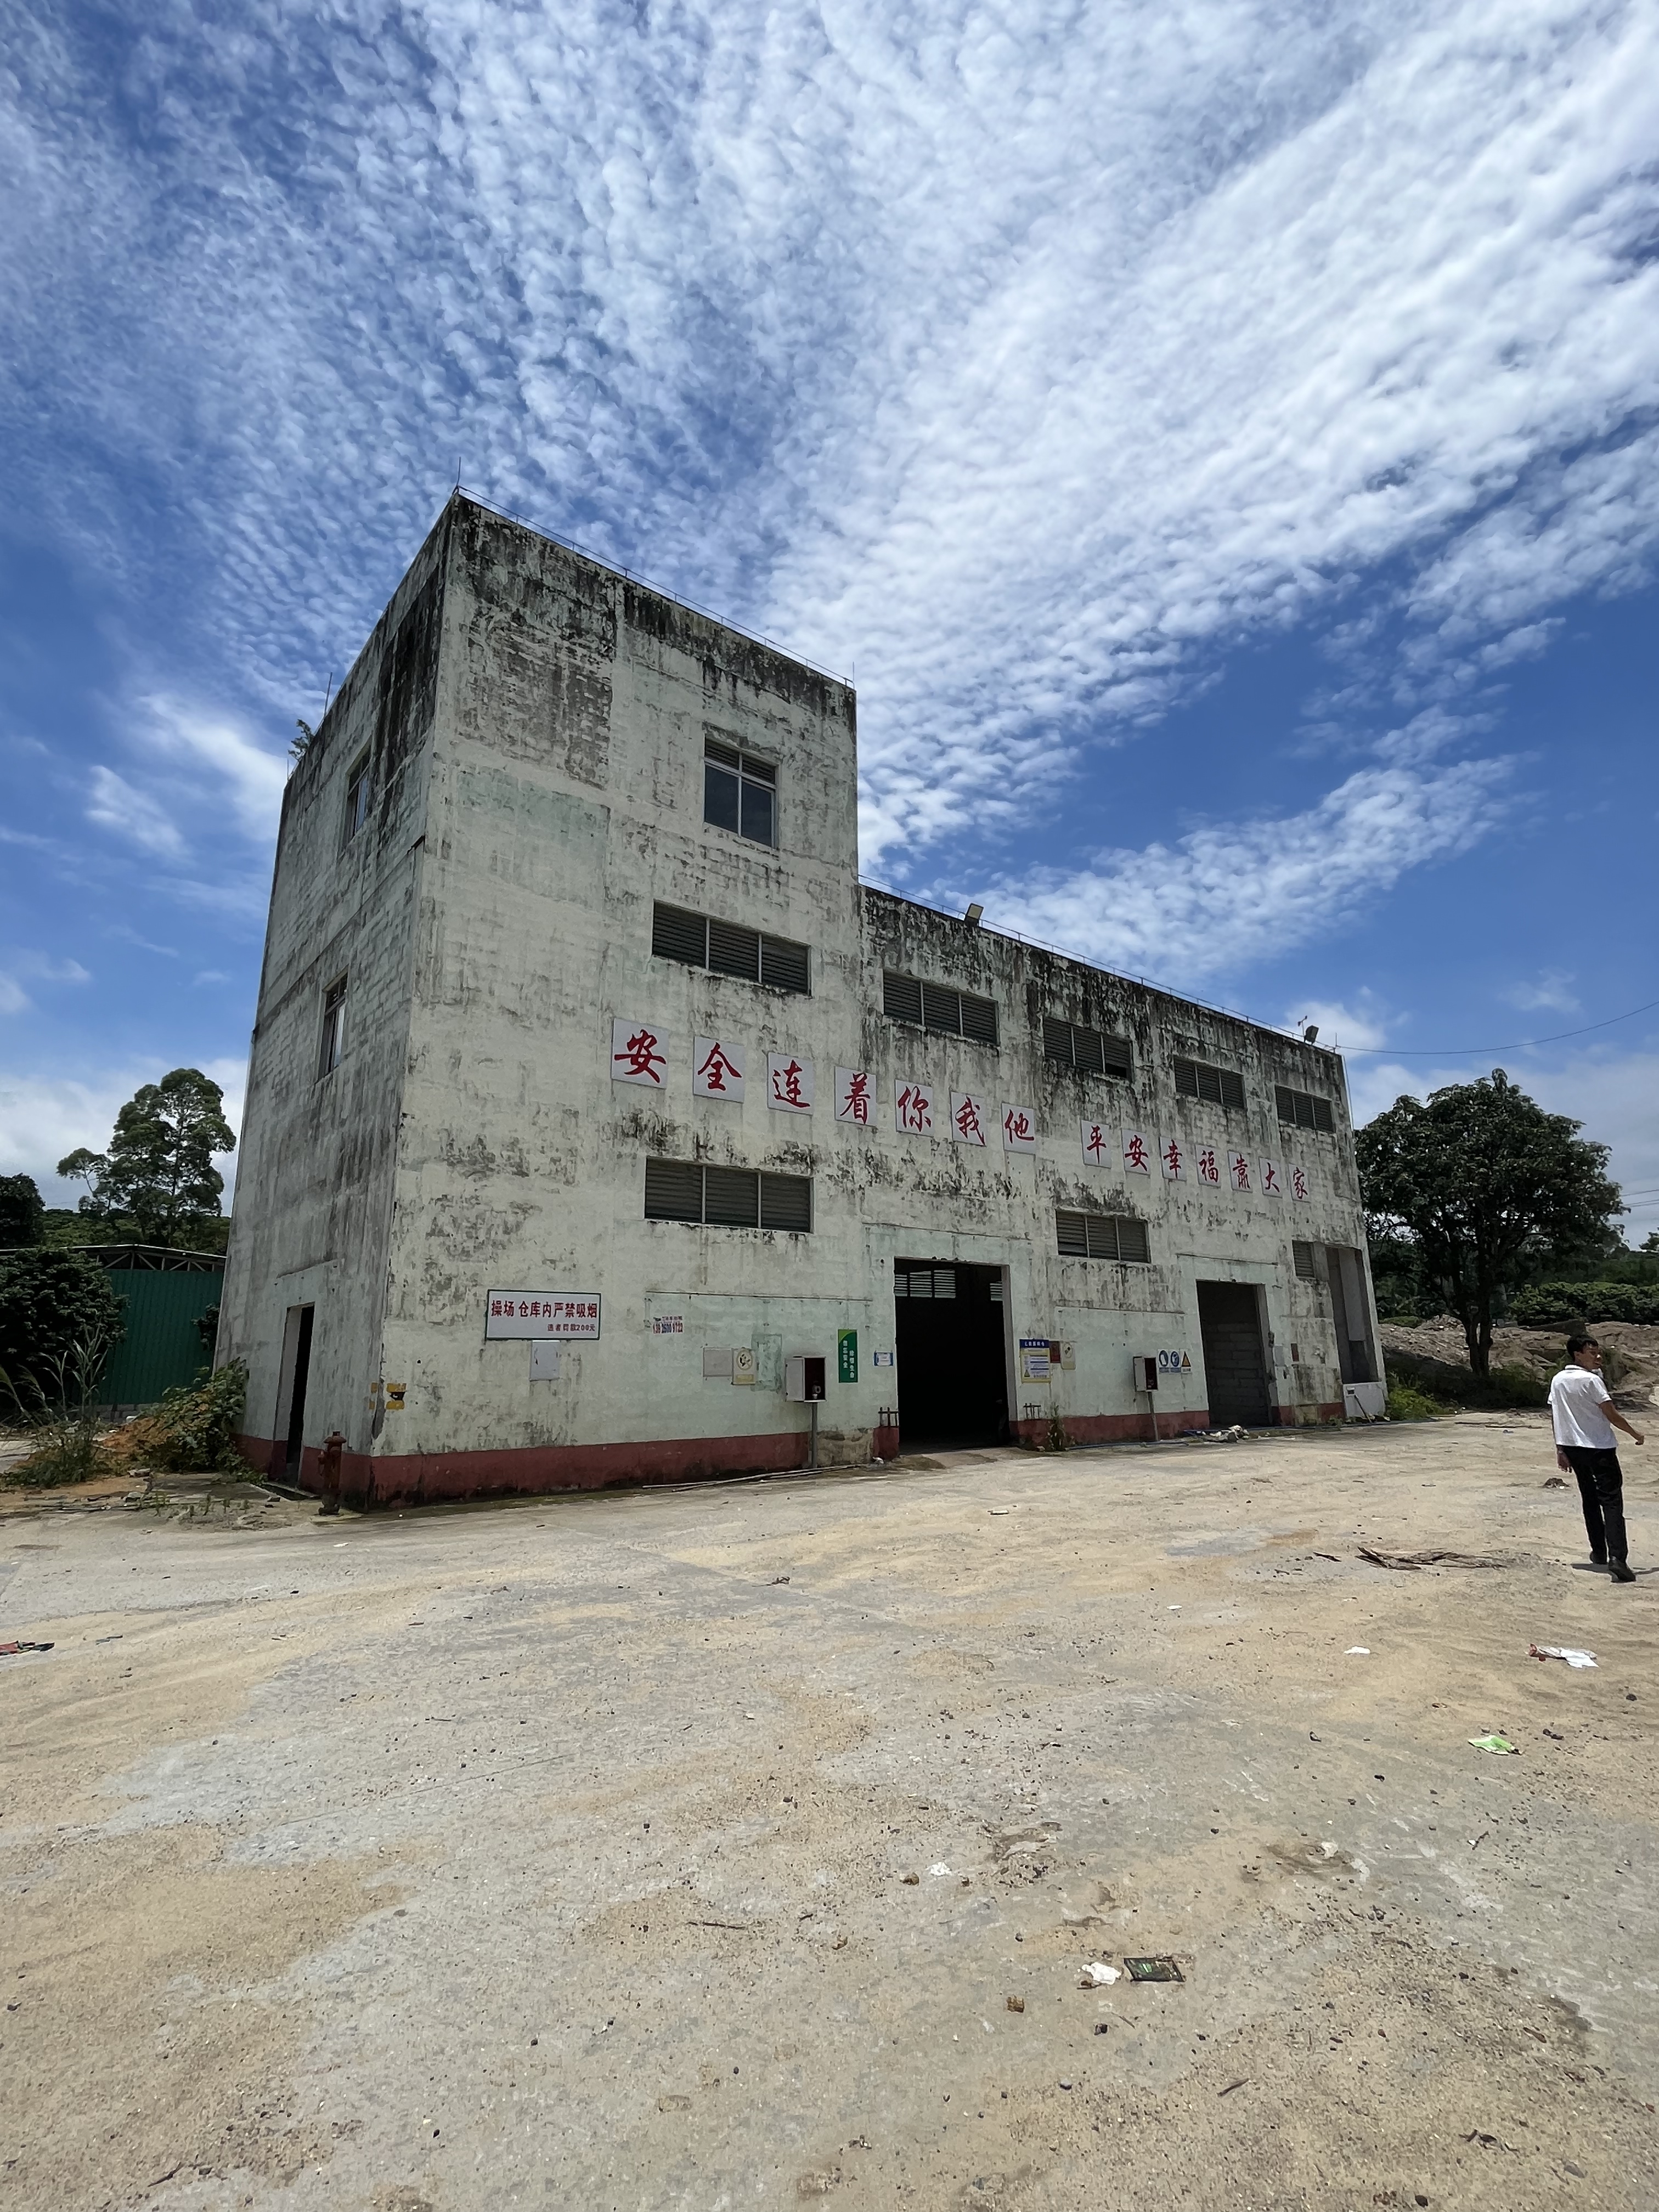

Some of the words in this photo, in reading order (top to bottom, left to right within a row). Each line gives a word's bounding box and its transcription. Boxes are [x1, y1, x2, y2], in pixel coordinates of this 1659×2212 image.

[613, 1028, 1035, 1145] 安全连着你我他
[1086, 1125, 1308, 1199] 平安幸福靠大家
[491, 1300, 515, 1317] 操场
[518, 1301, 597, 1318] 仓库内严禁吸烟
